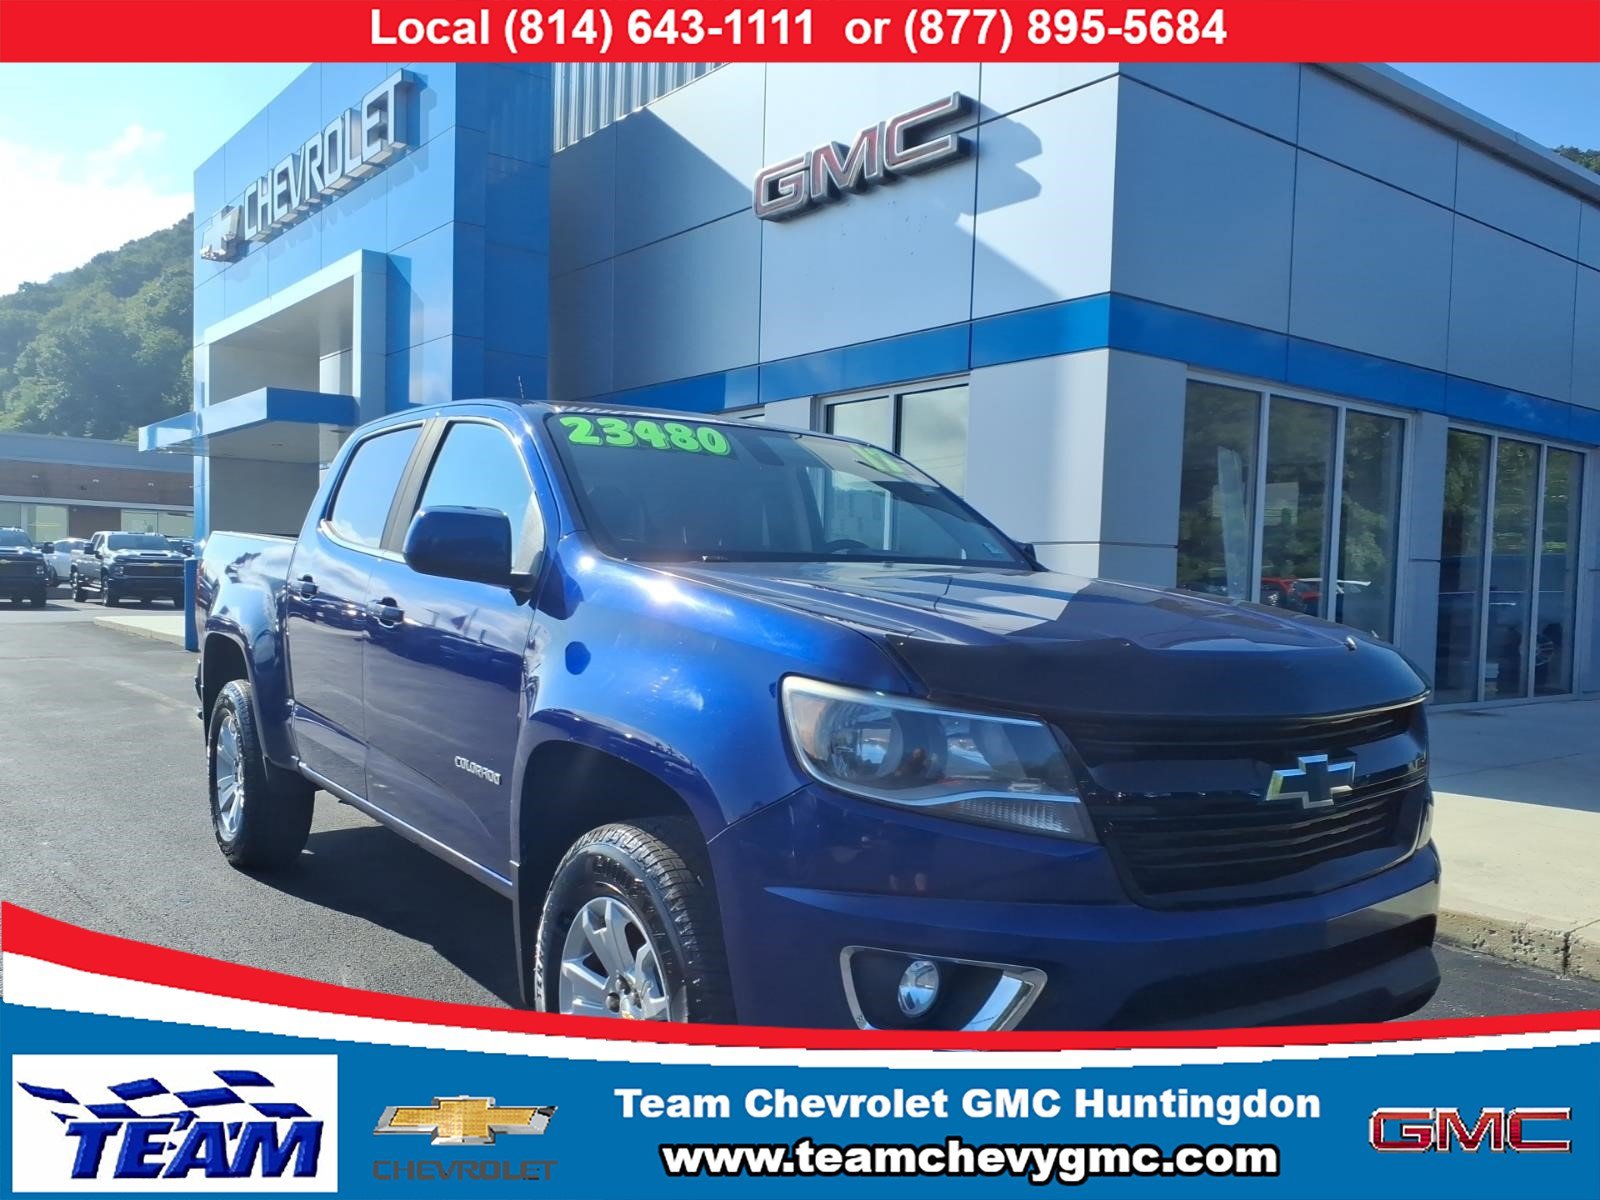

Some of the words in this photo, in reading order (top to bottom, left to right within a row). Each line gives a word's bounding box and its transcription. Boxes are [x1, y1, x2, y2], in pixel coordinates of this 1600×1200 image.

[243, 68, 408, 241] CHEVROLET
[752, 91, 964, 220] GMC
[559, 416, 732, 456] 23480
[454, 755, 502, 785] COLORADO
